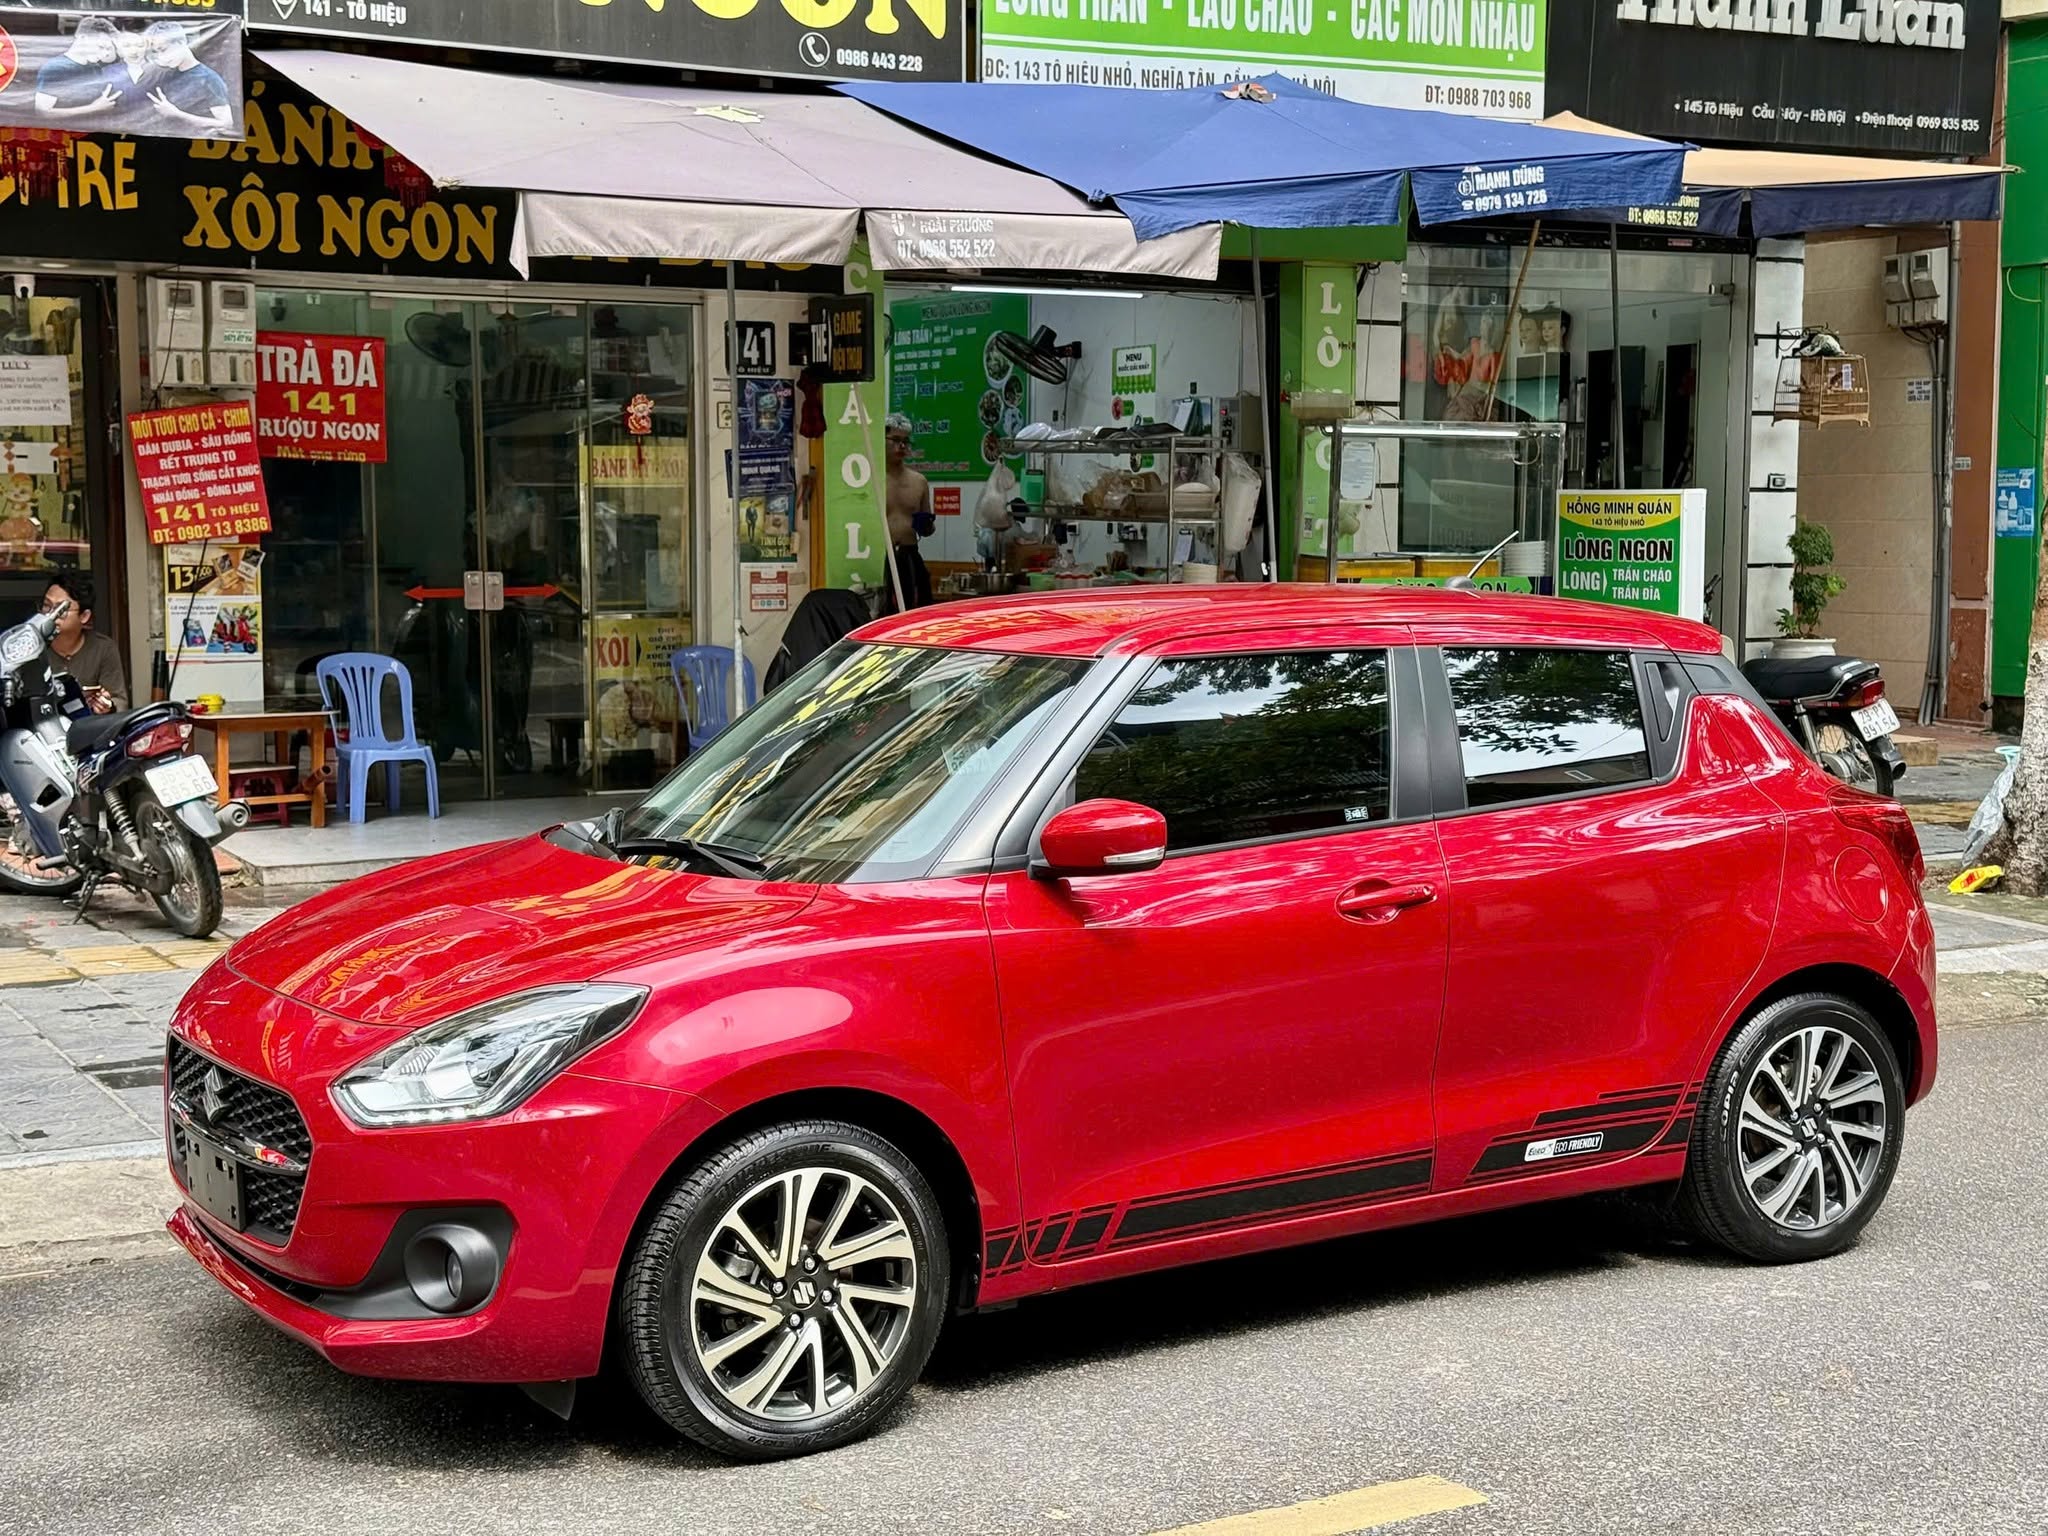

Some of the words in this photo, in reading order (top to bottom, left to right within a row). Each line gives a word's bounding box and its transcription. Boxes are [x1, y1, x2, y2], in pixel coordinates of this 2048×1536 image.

[836, 49, 869, 69] 0986
[871, 51, 896, 70] 443
[898, 53, 923, 72] 228
[985, 58, 1010, 79] ĐC:
[1014, 61, 1040, 81] 143
[1141, 64, 1184, 90] NGHĨA
[1425, 85, 1444, 105] ĐT:
[1448, 87, 1479, 107] 0988
[1482, 89, 1505, 108] 703
[1508, 91, 1532, 110] 968
[1917, 115, 1940, 129] 0969
[1942, 117, 1960, 130] 835
[1961, 119, 1980, 132] 835
[1475, 170, 1511, 192] MẠNH
[1512, 165, 1545, 187] DŨNG
[1475, 195, 1502, 212] 0979
[1504, 192, 1525, 209] 134
[183, 172, 301, 253] XÔI
[317, 194, 497, 265] NGON
[1667, 210, 1682, 226] 552
[1683, 211, 1699, 227] 522
[950, 239, 971, 258] 552
[973, 239, 996, 258] 522
[833, 310, 862, 337] GAME
[257, 338, 323, 385] TRÀ
[331, 342, 378, 388] ĐÁ
[1125, 353, 1142, 362] MENU
[283, 390, 356, 416] 141
[178, 413, 200, 434] CHO
[201, 408, 217, 431] CÁ
[223, 407, 250, 429] CHIM
[258, 416, 317, 444] RƯỢU
[323, 420, 380, 442] NGON
[223, 450, 237, 462] TO
[154, 502, 206, 525] 141
[1604, 502, 1634, 514] MINH
[1637, 498, 1672, 515] QUÁN
[178, 523, 212, 542] 0902
[214, 521, 232, 536] 13
[234, 516, 269, 535] 8386
[1564, 532, 1613, 561] LÒNG
[1618, 538, 1673, 562] NGON
[1562, 567, 1600, 591] LÒNG
[1643, 567, 1672, 583] CHÁO
[594, 628, 630, 668] XÔI
[1555, 1141, 1568, 1153] ECO
[1568, 1136, 1601, 1151] FRIENDLY
